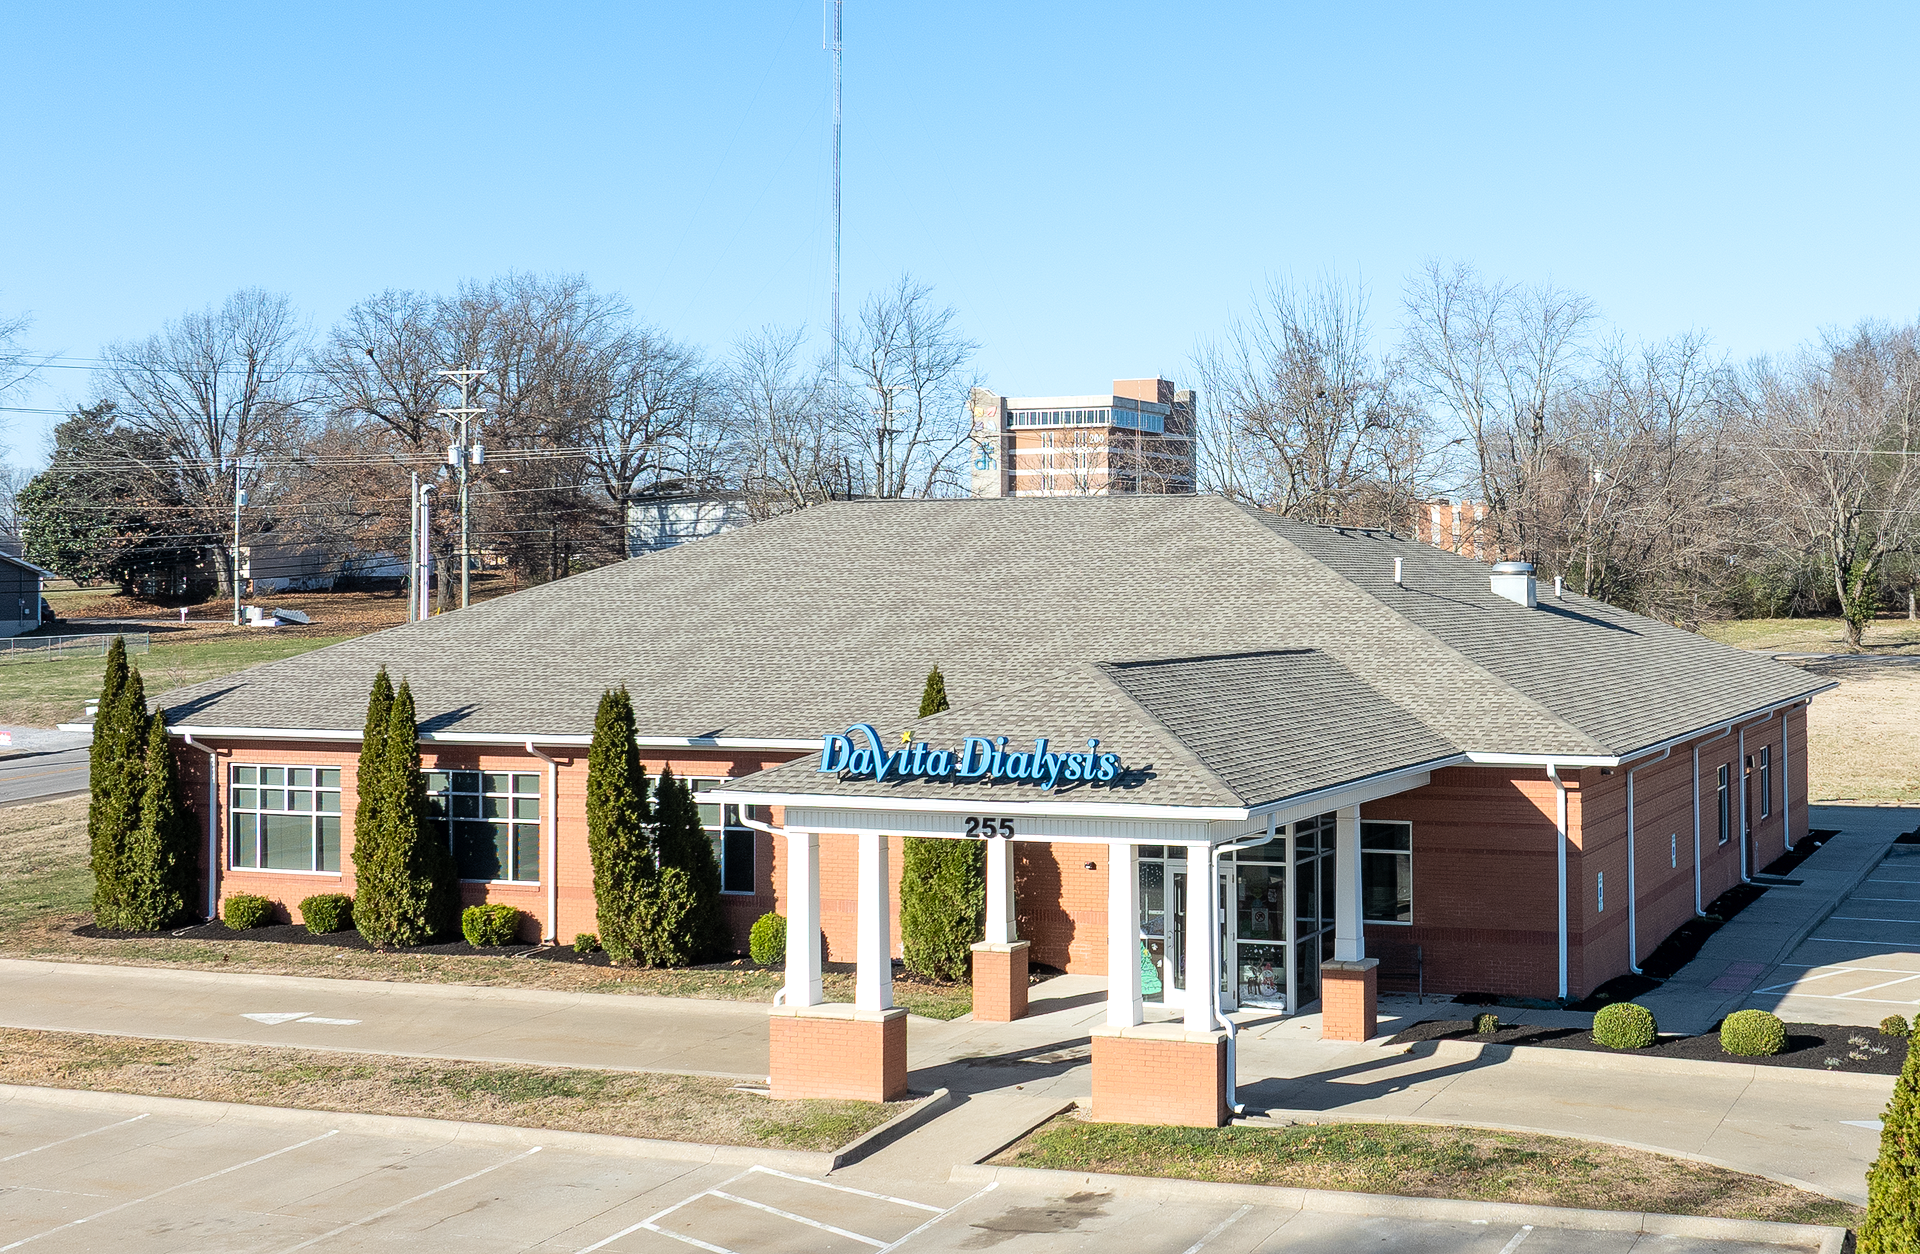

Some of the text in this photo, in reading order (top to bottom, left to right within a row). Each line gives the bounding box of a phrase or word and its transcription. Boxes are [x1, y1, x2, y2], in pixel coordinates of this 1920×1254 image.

[816, 723, 1121, 791] DaVita Dialysis
[965, 816, 1016, 840] 255
